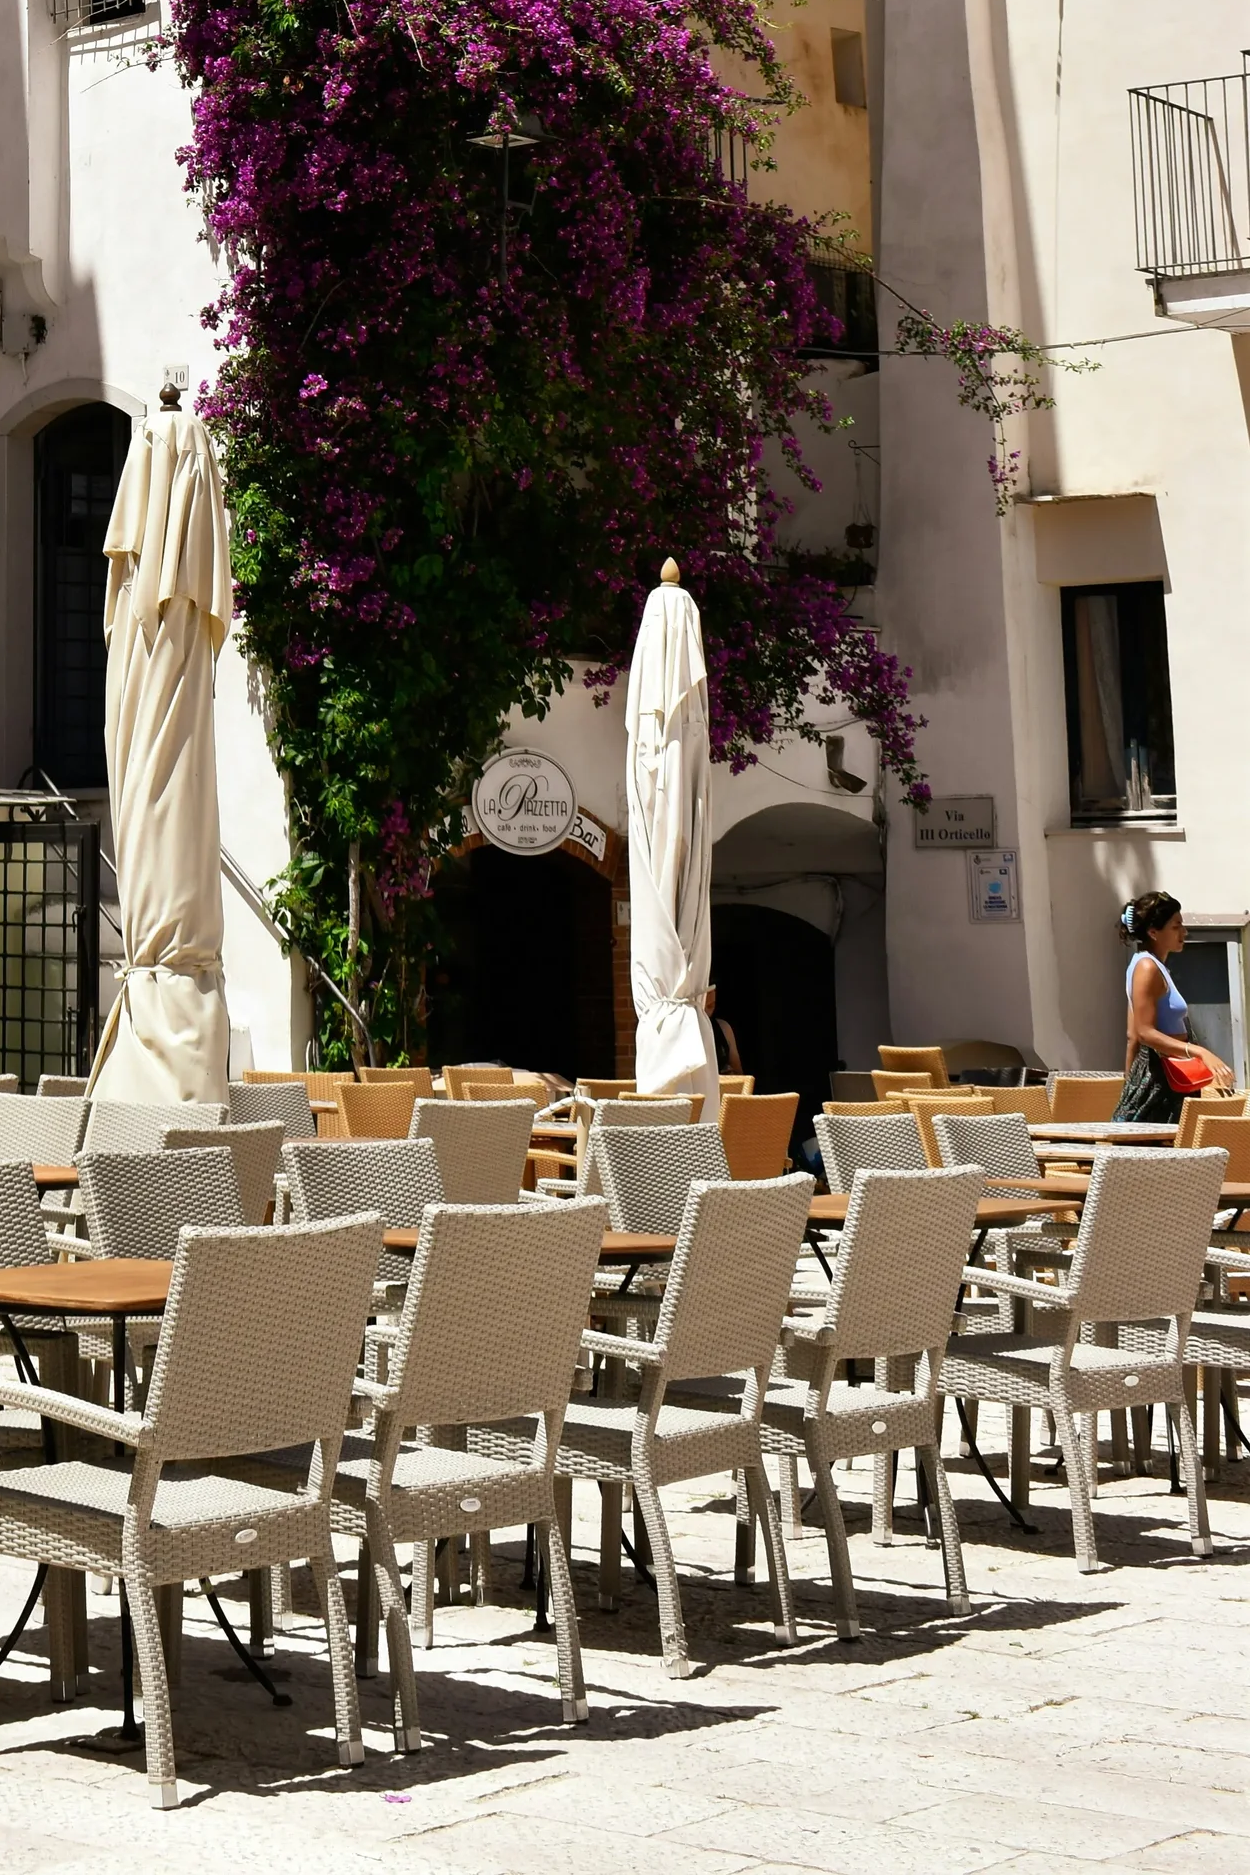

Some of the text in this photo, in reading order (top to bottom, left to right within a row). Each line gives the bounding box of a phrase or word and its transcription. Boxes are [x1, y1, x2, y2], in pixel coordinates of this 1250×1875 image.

[175, 371, 185, 384] 10
[483, 798, 496, 815] LA
[944, 810, 964, 822] Via
[542, 825, 557, 833] food
[569, 816, 599, 848] Bar
[919, 828, 991, 841] III Orticello
